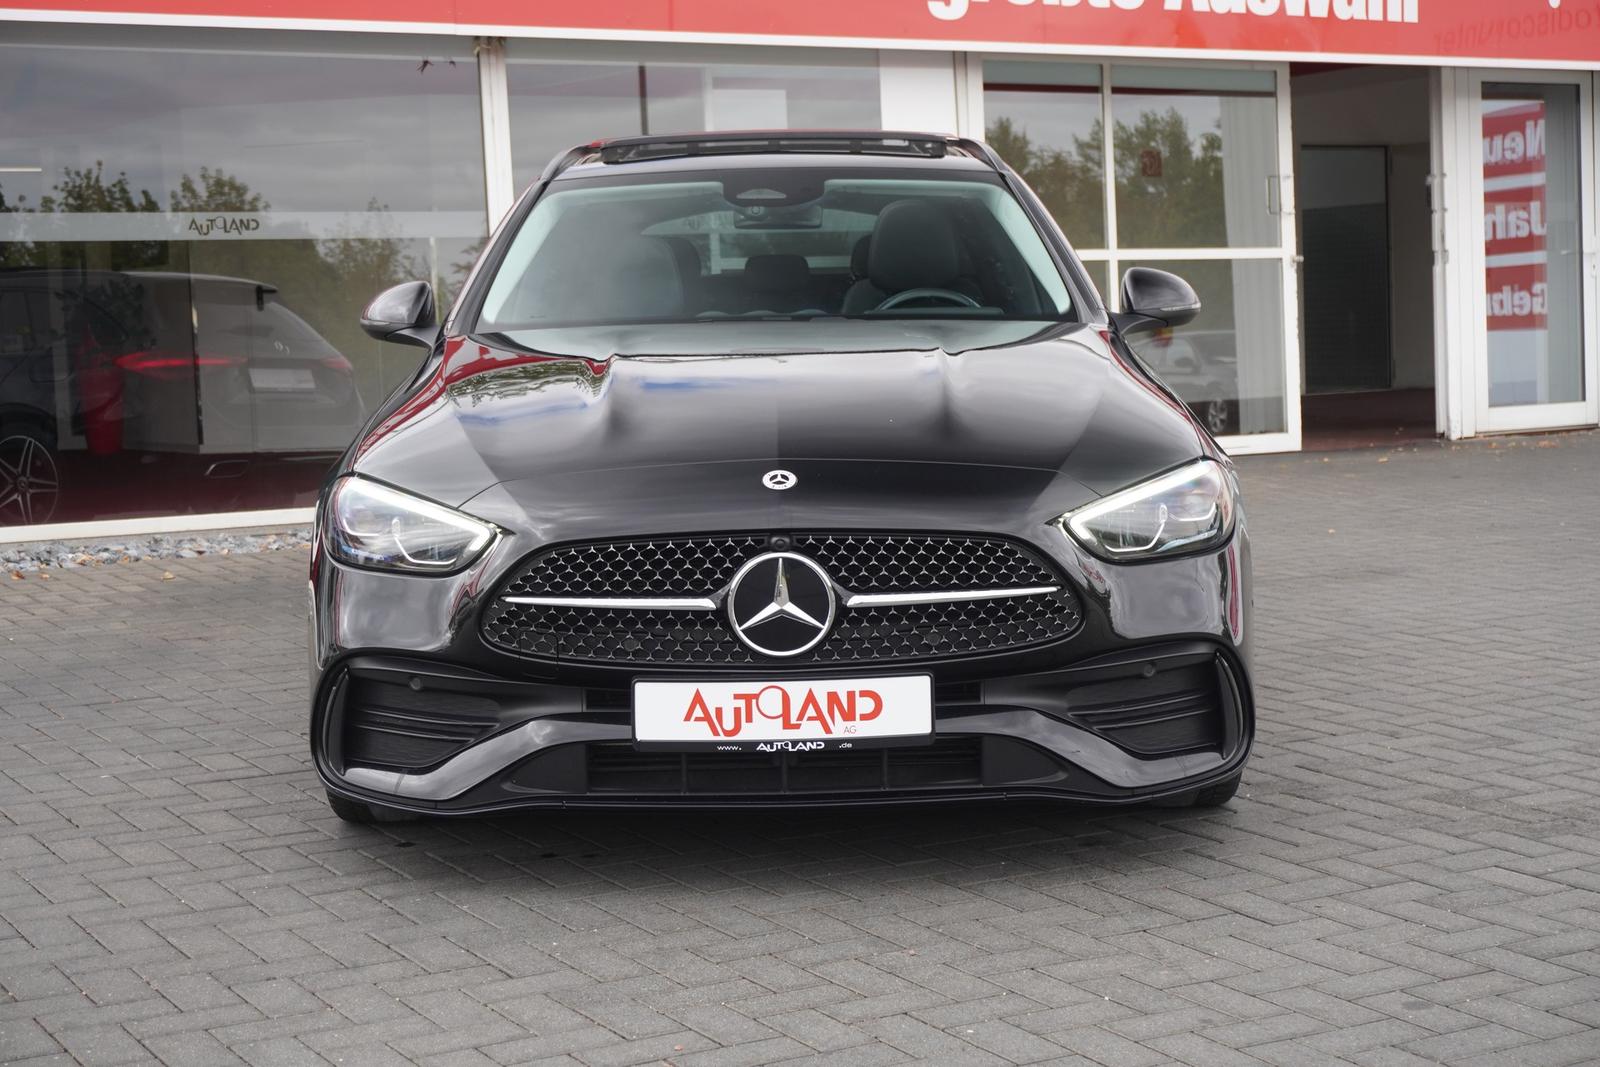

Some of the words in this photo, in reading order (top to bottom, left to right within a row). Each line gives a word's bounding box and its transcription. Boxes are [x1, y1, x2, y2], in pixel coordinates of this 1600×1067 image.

[188, 216, 260, 236] AUTOLAND
[683, 685, 884, 738] AUTOLAND
[843, 725, 857, 735] AG
[756, 740, 825, 753] AUTOLAND
